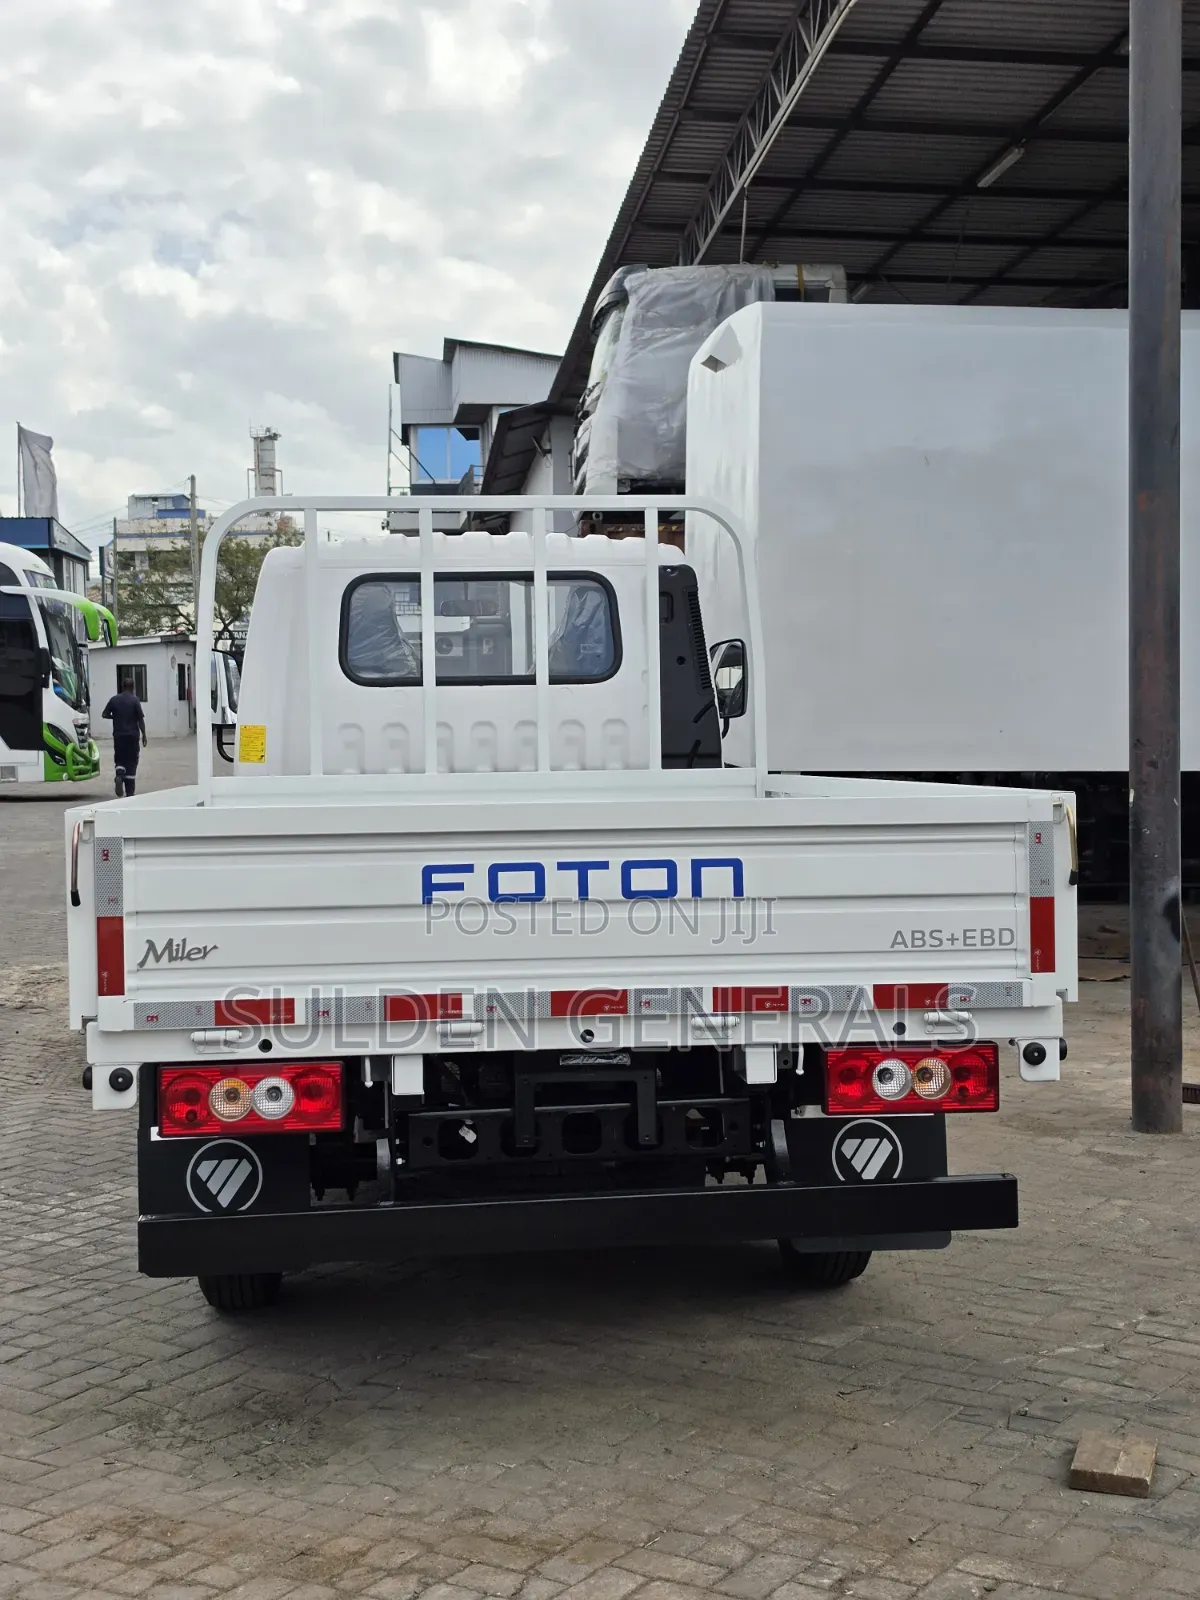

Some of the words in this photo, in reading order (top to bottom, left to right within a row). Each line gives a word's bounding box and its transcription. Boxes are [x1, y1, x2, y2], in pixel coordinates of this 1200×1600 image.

[421, 857, 745, 905] FOTON
[137, 937, 219, 968] Miler
[889, 927, 1015, 949] ABS+EBD
